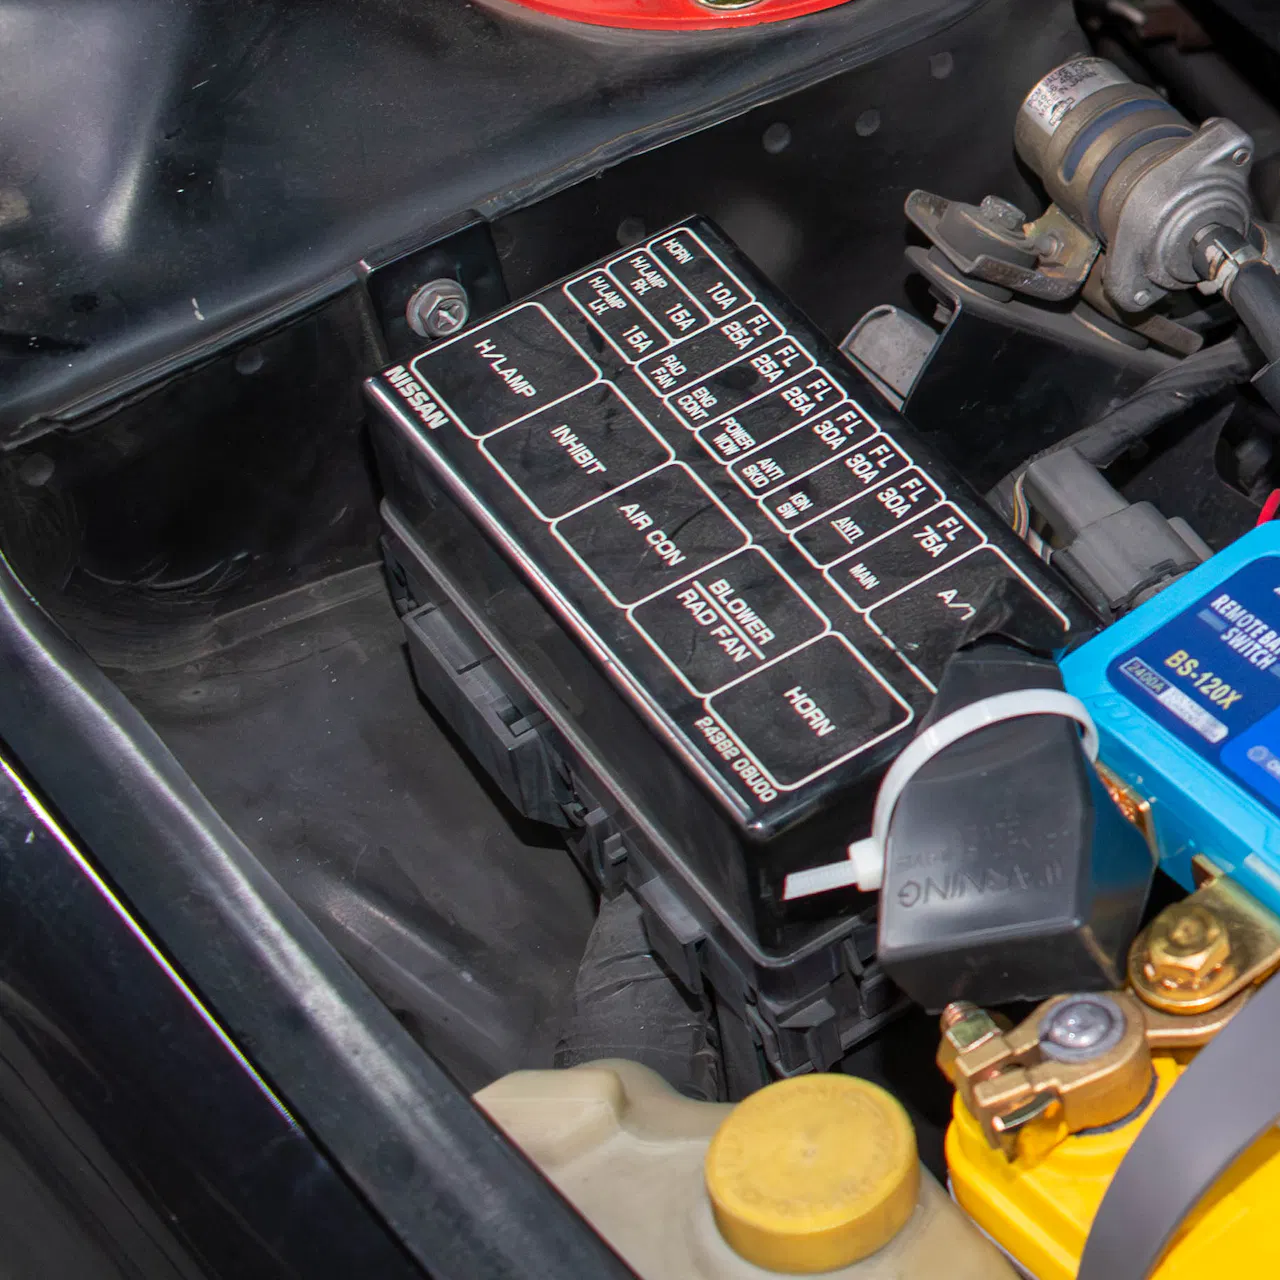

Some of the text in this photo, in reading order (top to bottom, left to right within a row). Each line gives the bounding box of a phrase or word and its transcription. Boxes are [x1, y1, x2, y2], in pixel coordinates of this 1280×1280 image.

[662, 237, 739, 310] HORN 10A
[628, 254, 698, 331] H/LAMP 15A
[587, 275, 656, 353] H/LAMP 15A
[744, 312, 774, 336] FL
[719, 319, 757, 350] 25A
[472, 338, 538, 401] H/LAMP
[659, 353, 688, 377] RAD
[749, 352, 787, 384] 25A
[773, 344, 803, 368] FL
[649, 366, 677, 389] FAN
[805, 377, 836, 402] FL
[381, 364, 451, 430] NISSAN
[676, 393, 709, 422] CONT
[691, 386, 718, 408] ENG
[780, 385, 817, 417] 25A
[718, 416, 756, 450] POWER
[811, 418, 849, 451] 30A
[834, 409, 866, 435] FL
[549, 423, 607, 478] INHIBIT
[711, 432, 740, 456] WDW
[867, 443, 899, 469] FL
[740, 463, 770, 489] SKID
[755, 455, 785, 481] ANTI
[843, 451, 882, 484] 30A
[787, 490, 813, 512] IGN
[874, 485, 914, 519] 30A
[898, 476, 931, 503] FL
[774, 501, 798, 520] SW
[617, 499, 686, 566] AIR CON
[833, 514, 864, 541] ANTI
[911, 524, 951, 558] 75A
[935, 515, 968, 542] FL
[847, 562, 880, 591] MAIN
[675, 586, 753, 662] RAD FAN
[707, 577, 776, 645] BLOWER
[1208, 593, 1272, 640] REMOTE
[1218, 626, 1277, 671] SWITCH
[1162, 648, 1244, 711] BS-120X
[780, 684, 836, 737] HORN
[693, 714, 779, 804] 24382 08U00
